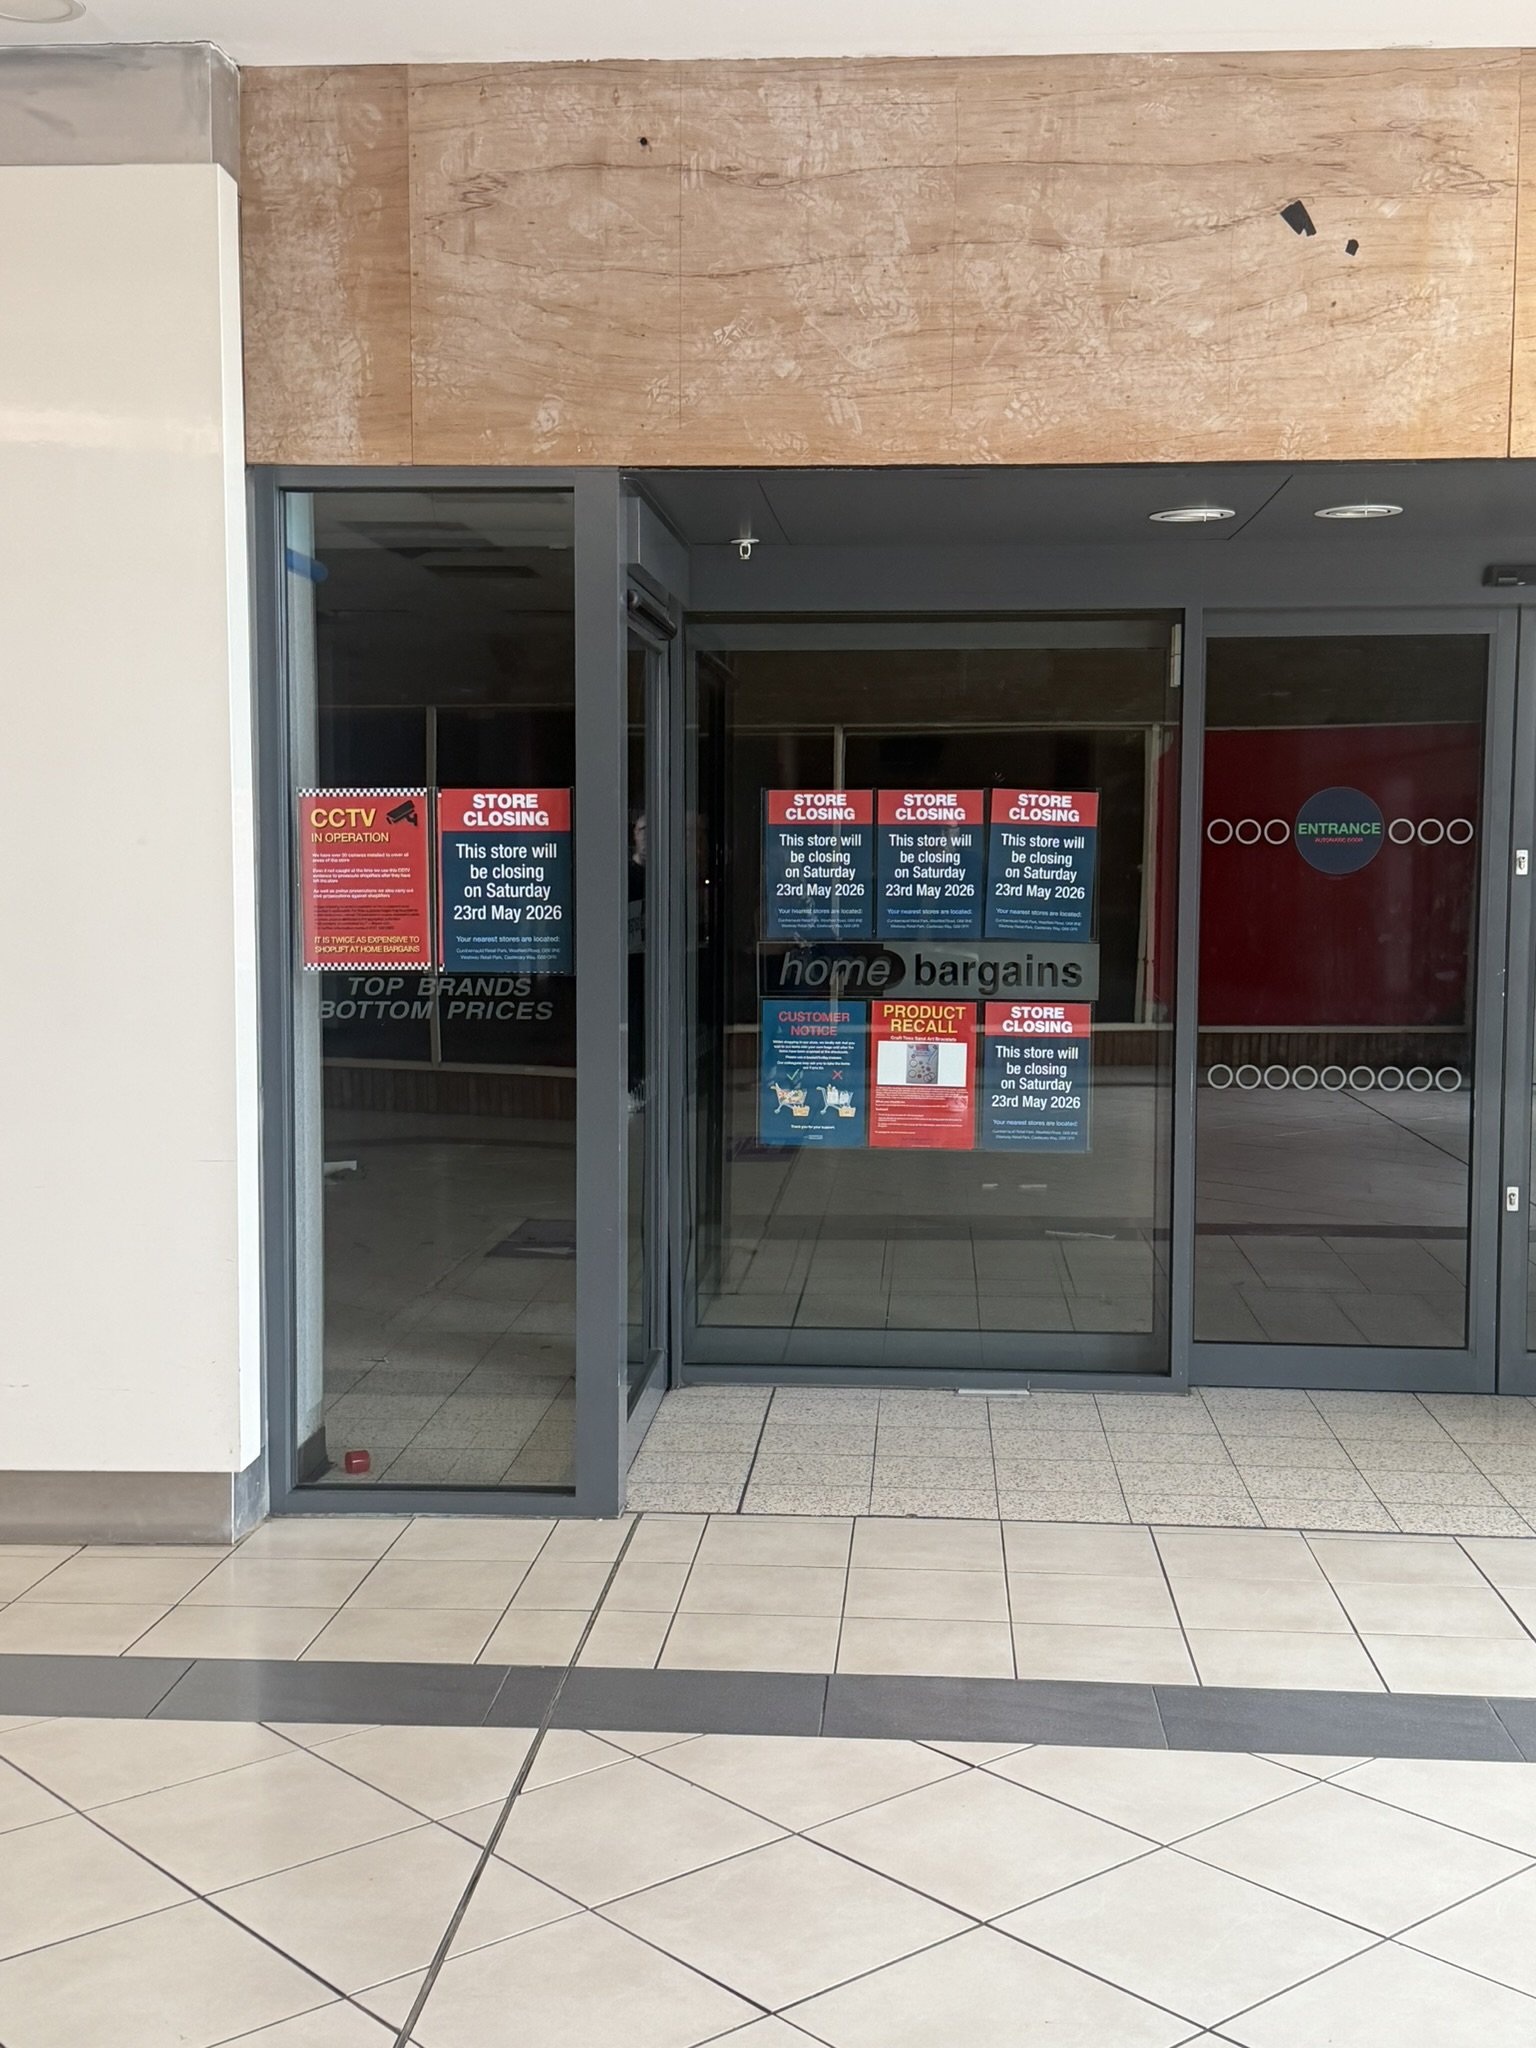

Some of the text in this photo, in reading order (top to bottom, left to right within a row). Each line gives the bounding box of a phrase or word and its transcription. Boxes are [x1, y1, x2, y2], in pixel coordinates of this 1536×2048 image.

[473, 794, 538, 809] STORE
[793, 794, 847, 806] STORE
[903, 794, 957, 806] STORE
[1017, 794, 1072, 808] STORE
[311, 808, 376, 828] CCTV
[463, 811, 549, 826] CLOSING
[785, 808, 855, 820] CLOSING
[895, 808, 966, 820] CLOSING
[1009, 808, 1080, 822] CLOSING
[1298, 823, 1381, 834] ENTRANCE
[311, 832, 389, 842] IN OPERATION
[779, 834, 861, 847] This store will
[888, 834, 971, 847] This store will
[1001, 833, 1085, 849] This store will
[456, 843, 557, 858] This store will
[790, 850, 850, 865] be closing
[900, 850, 960, 865] be closing
[1011, 850, 1073, 868] be closing
[470, 864, 544, 882] be closing
[785, 865, 856, 880] on Saturday
[894, 866, 966, 881] on Saturday
[1005, 866, 1077, 883] on Saturday
[464, 882, 550, 901] on Saturday
[776, 883, 864, 899] 23rd May 2026
[885, 884, 974, 899] 23rd May 2026
[995, 883, 1085, 900] 23rd May 2026
[453, 905, 562, 923] 23rd May 2026
[314, 936, 420, 944] IT IS TWICE AS EXPENSIVE TO
[314, 945, 420, 953] SHOPLIFT AT HOME BARGAINS
[779, 951, 1083, 995] home bargains
[348, 977, 531, 996] TOP BRANDS
[320, 1001, 553, 1020] BOTTOM PRICES
[778, 1011, 850, 1022] CUSTOMER
[883, 1004, 966, 1020] PRODUCT
[1010, 1006, 1064, 1019] STORE
[790, 1026, 838, 1036] NOTICE
[890, 1018, 958, 1033] RECALL
[1002, 1020, 1073, 1033] CLOSING
[995, 1045, 1078, 1060] This store will
[1006, 1062, 1067, 1078] be closing
[1000, 1077, 1072, 1093] on Saturday
[991, 1095, 1081, 1110] 23rd May 2026
